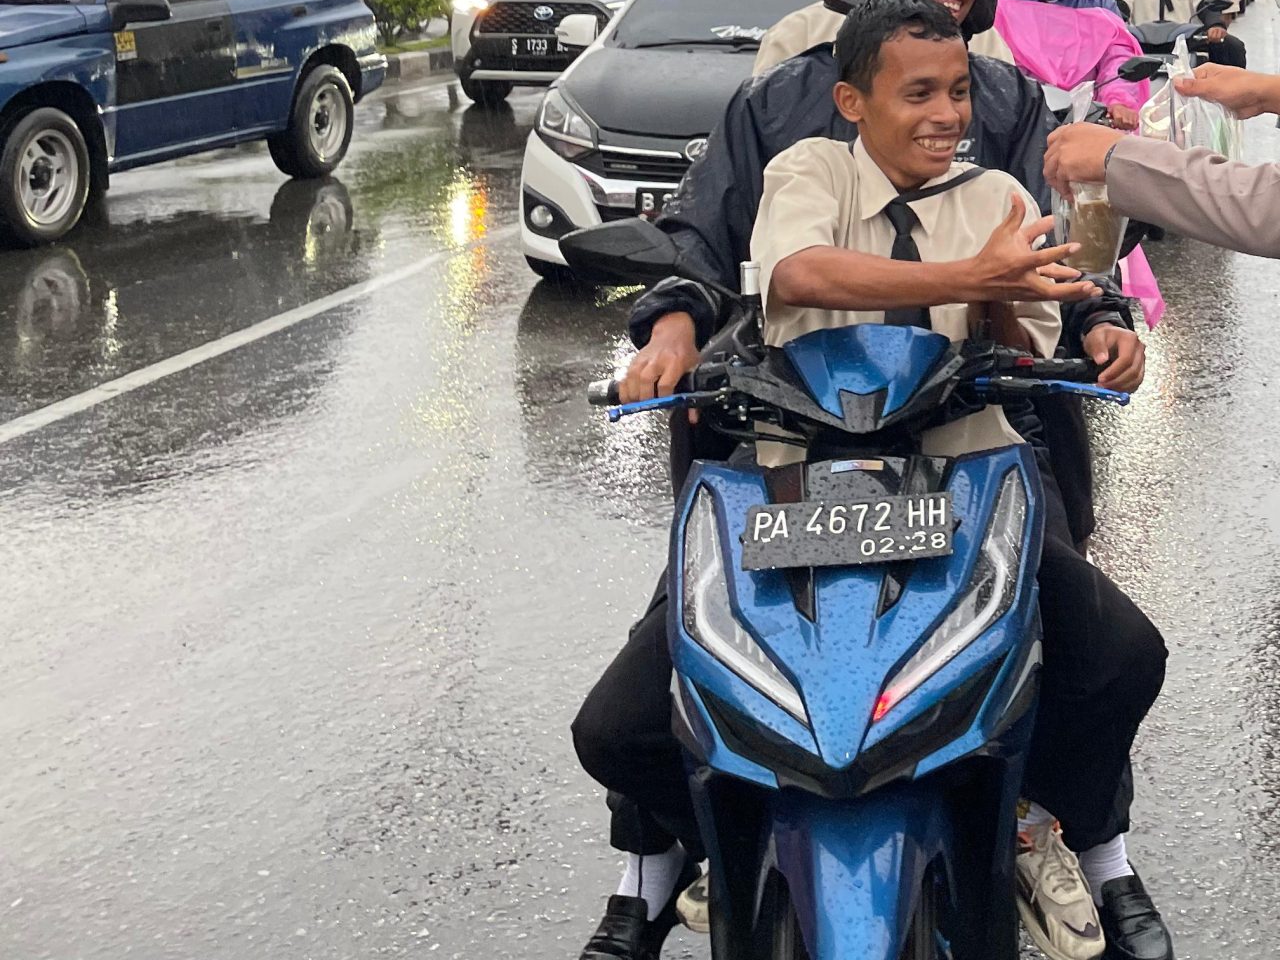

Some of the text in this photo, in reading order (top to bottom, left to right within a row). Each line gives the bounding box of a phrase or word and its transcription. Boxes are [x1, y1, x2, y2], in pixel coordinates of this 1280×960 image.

[641, 192, 655, 212] B
[753, 497, 946, 541] PA 4672 HH
